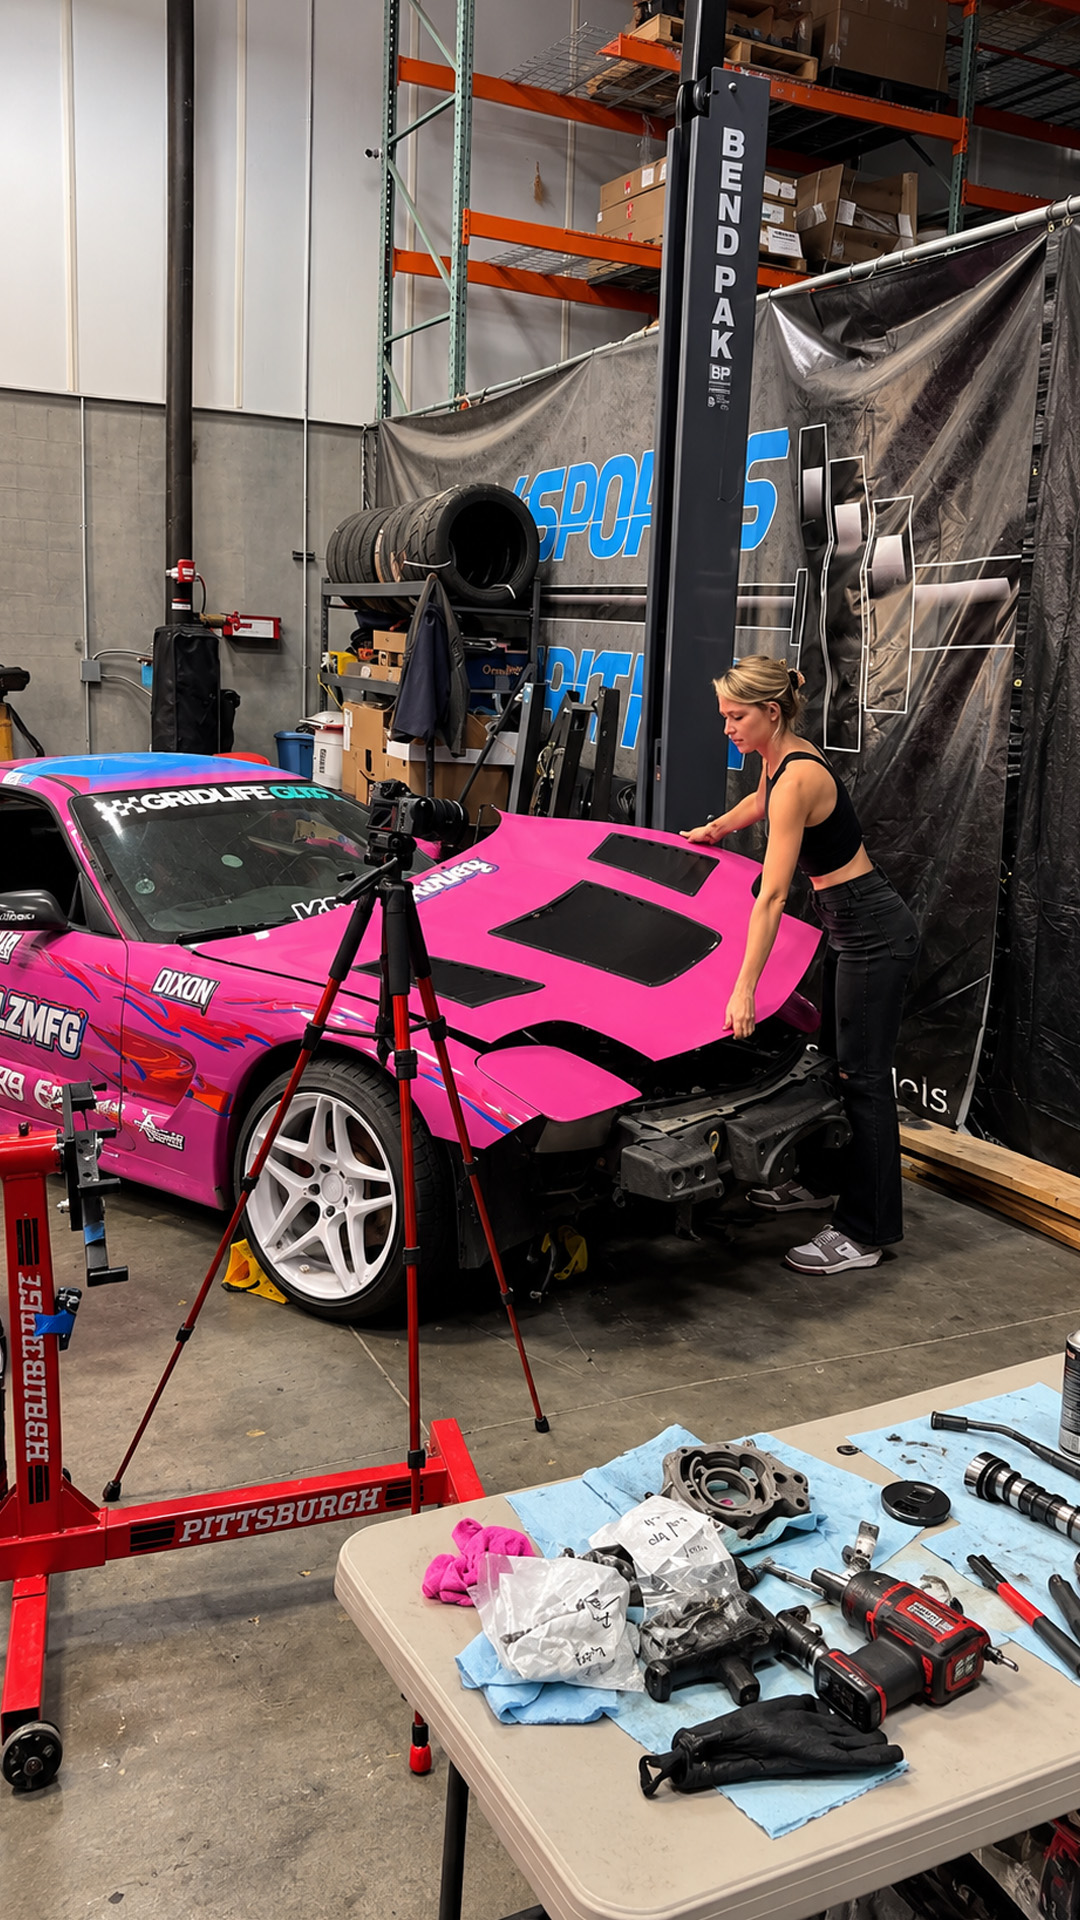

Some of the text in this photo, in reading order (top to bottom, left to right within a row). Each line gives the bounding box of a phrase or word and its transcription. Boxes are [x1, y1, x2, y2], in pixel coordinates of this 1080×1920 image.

[711, 365, 731, 381] BP
[140, 785, 275, 811] GRIDLIFE
[151, 968, 216, 1006] DIXON
[179, 1487, 383, 1543] PITTSBURGH
